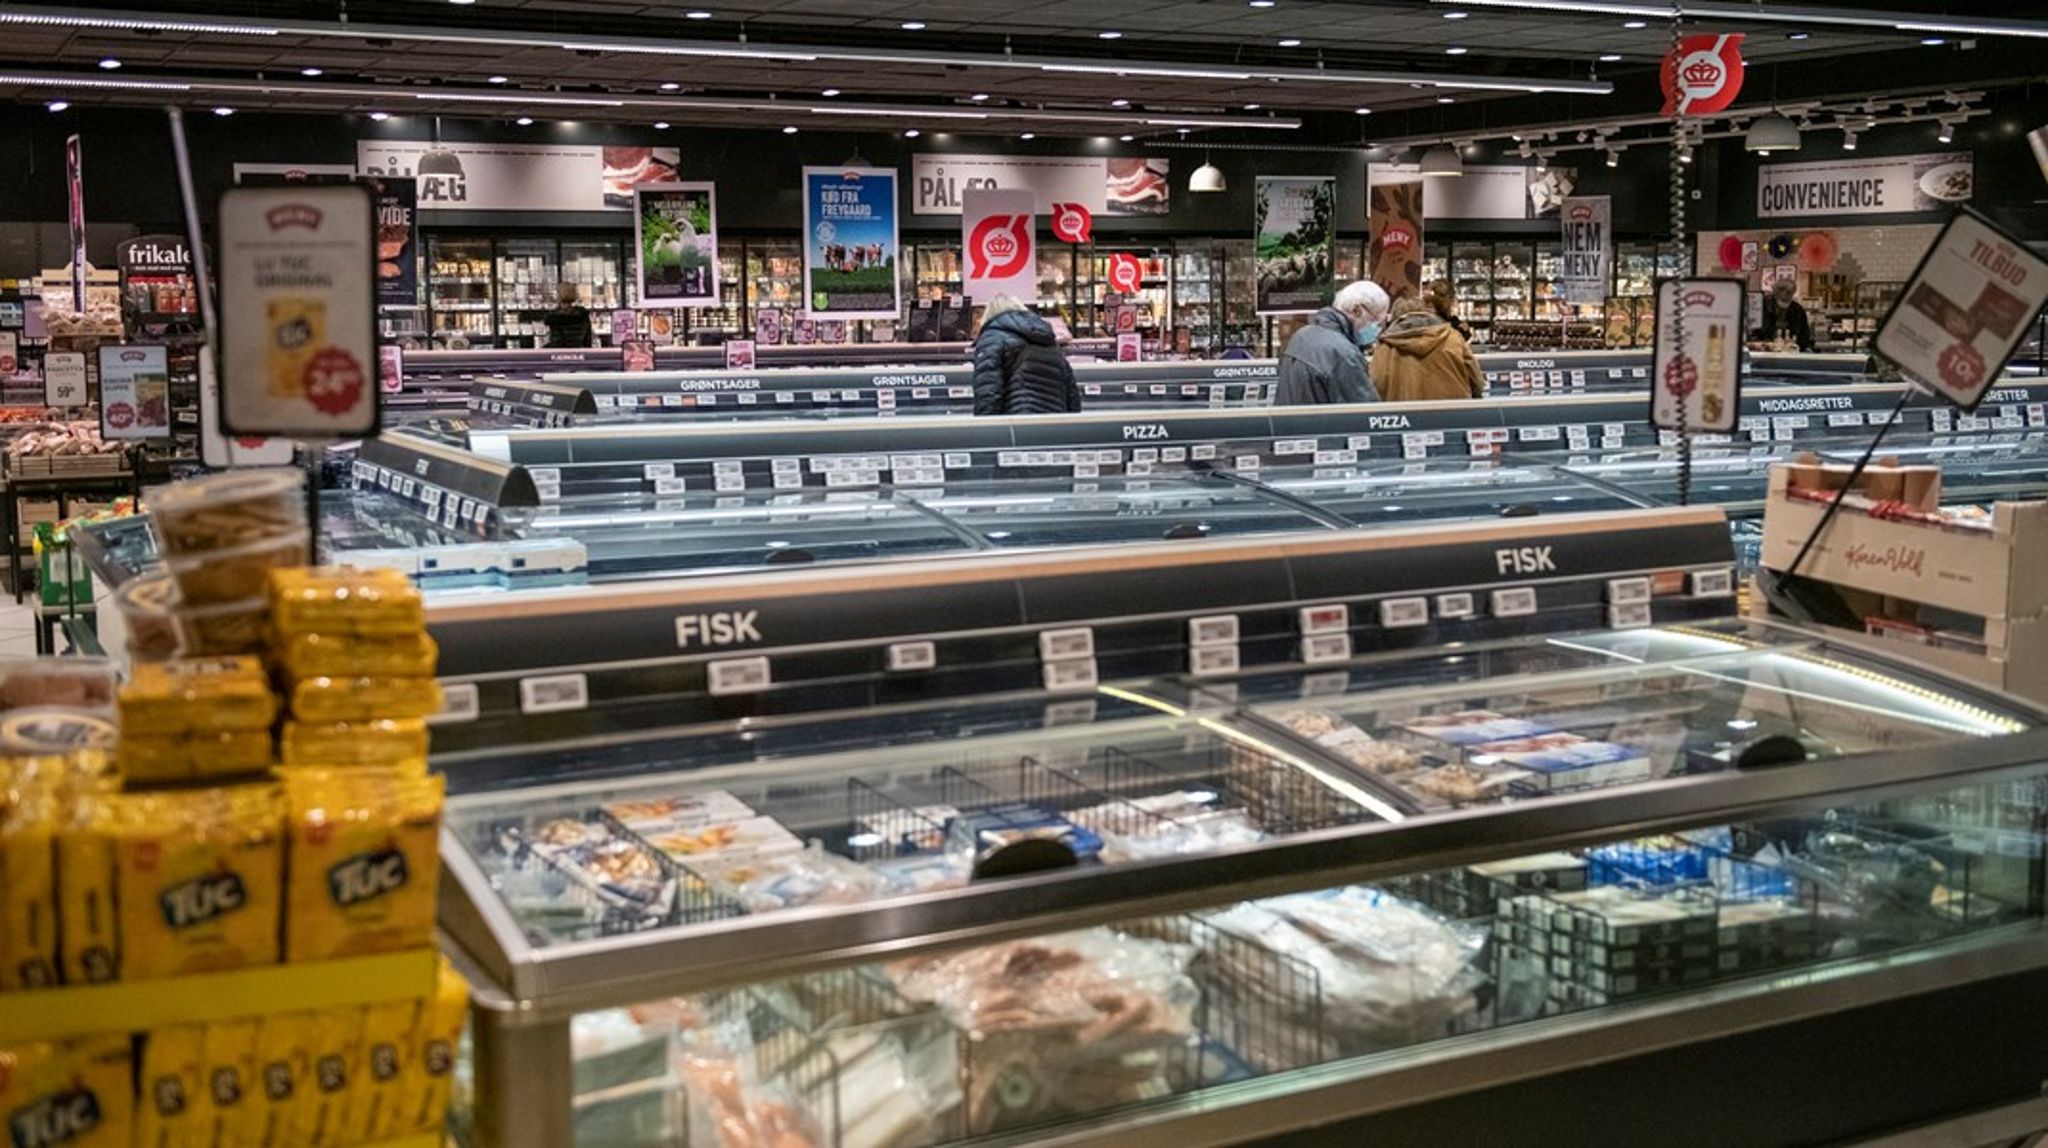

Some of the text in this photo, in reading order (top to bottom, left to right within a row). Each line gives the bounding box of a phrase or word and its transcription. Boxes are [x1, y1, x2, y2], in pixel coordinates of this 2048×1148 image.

[1762, 178, 1885, 211] CONVENIENCE
[1383, 231, 1410, 247] MENY
[1969, 238, 2028, 287] TILBUD
[1213, 366, 1278, 378] GRØNTSAGER
[1517, 359, 1555, 369] ØKOLOGI
[872, 374, 947, 386] GRØNTSAGER
[1759, 396, 1854, 412] MIDDAGSRETTER
[1123, 424, 1169, 440] PIZZA
[1369, 415, 1411, 429] PIZZA
[1494, 546, 1557, 575] FISK
[674, 609, 762, 648] FISK
[332, 854, 407, 906] TUC
[162, 875, 243, 926] TUC
[13, 1092, 98, 1148] TUC
